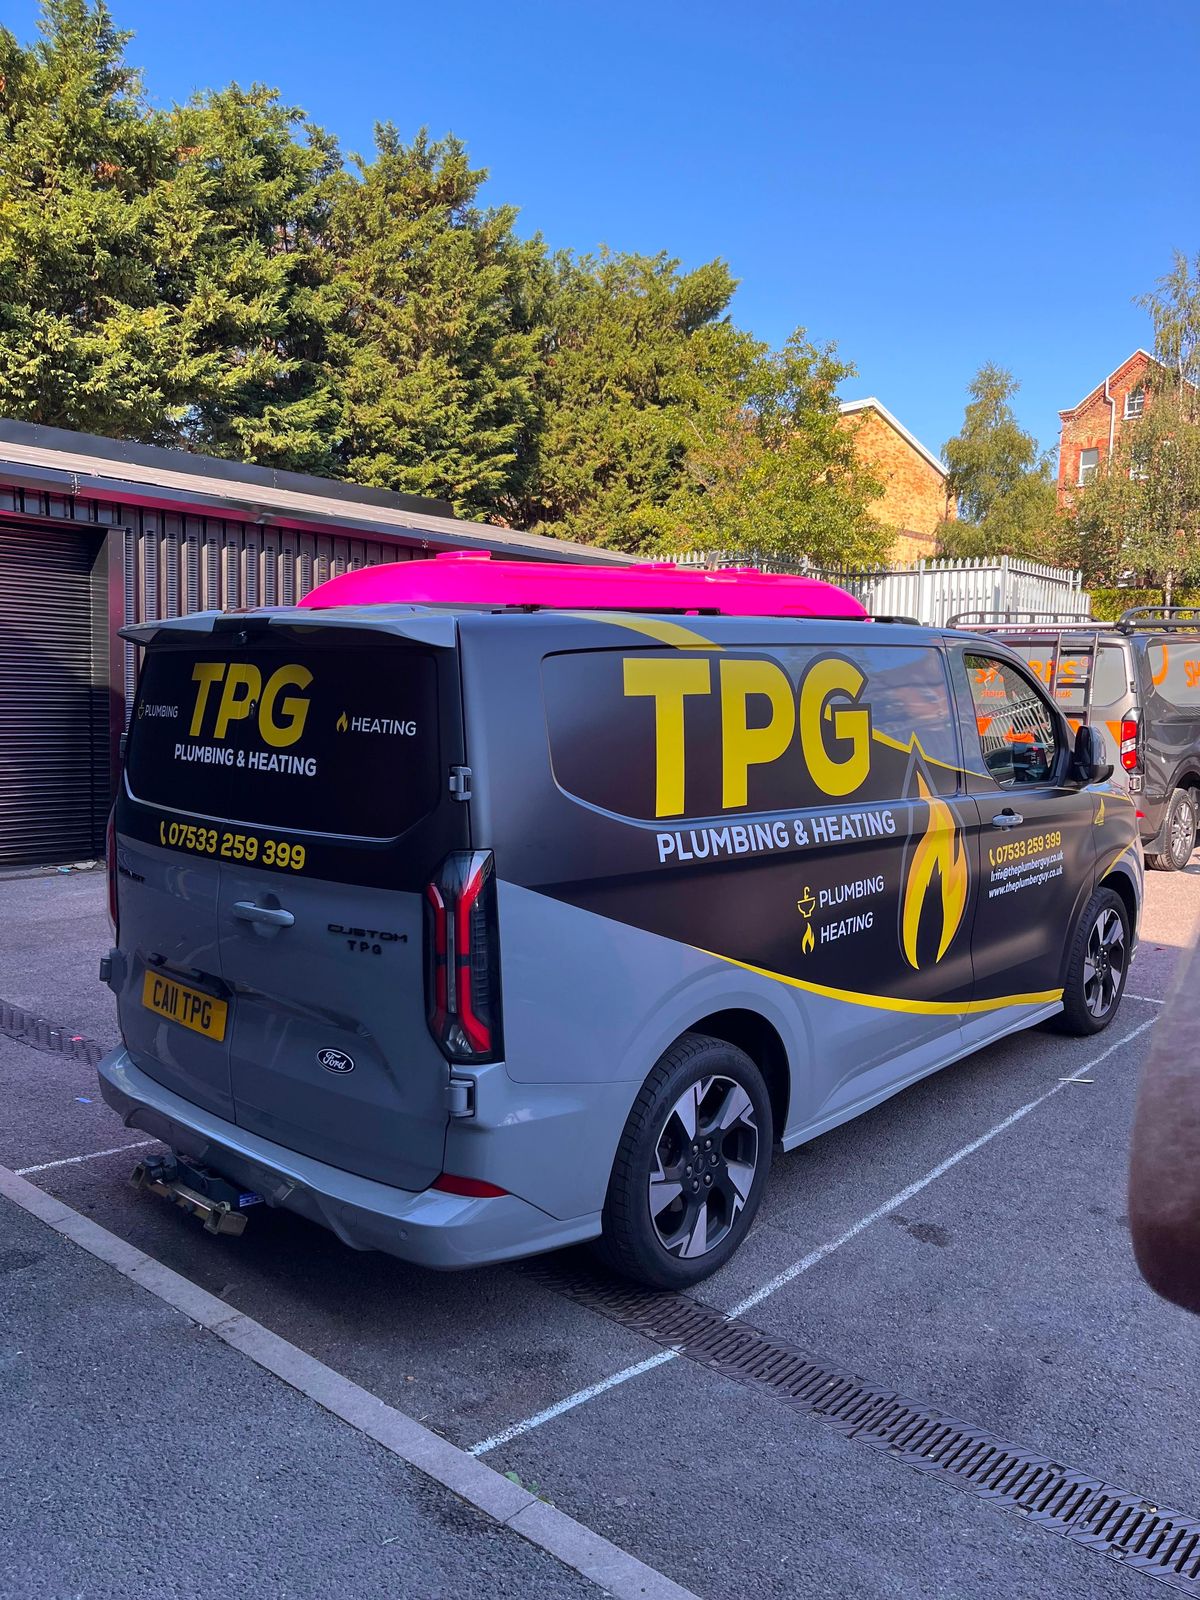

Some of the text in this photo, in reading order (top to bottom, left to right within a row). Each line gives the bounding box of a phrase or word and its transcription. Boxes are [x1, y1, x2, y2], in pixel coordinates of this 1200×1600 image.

[145, 704, 179, 719] PLUMBING
[189, 662, 314, 748] TPG
[351, 716, 417, 737] HEATING
[623, 658, 870, 817] TPG
[174, 743, 318, 777] PLUMBING & HEATING
[168, 825, 307, 870] 07533 259 399
[656, 810, 897, 864] PLUMBING & HEATING
[996, 830, 1062, 864] 07533 259 399
[819, 875, 885, 908] PLUMBING
[988, 864, 1064, 899] www.theplumberguy.co.uk
[327, 923, 408, 944] CUSTOM
[820, 911, 874, 944] HEATING
[347, 939, 383, 956] TPG
[153, 979, 213, 1030] CA11 TPG
[322, 1051, 347, 1070] Ford
